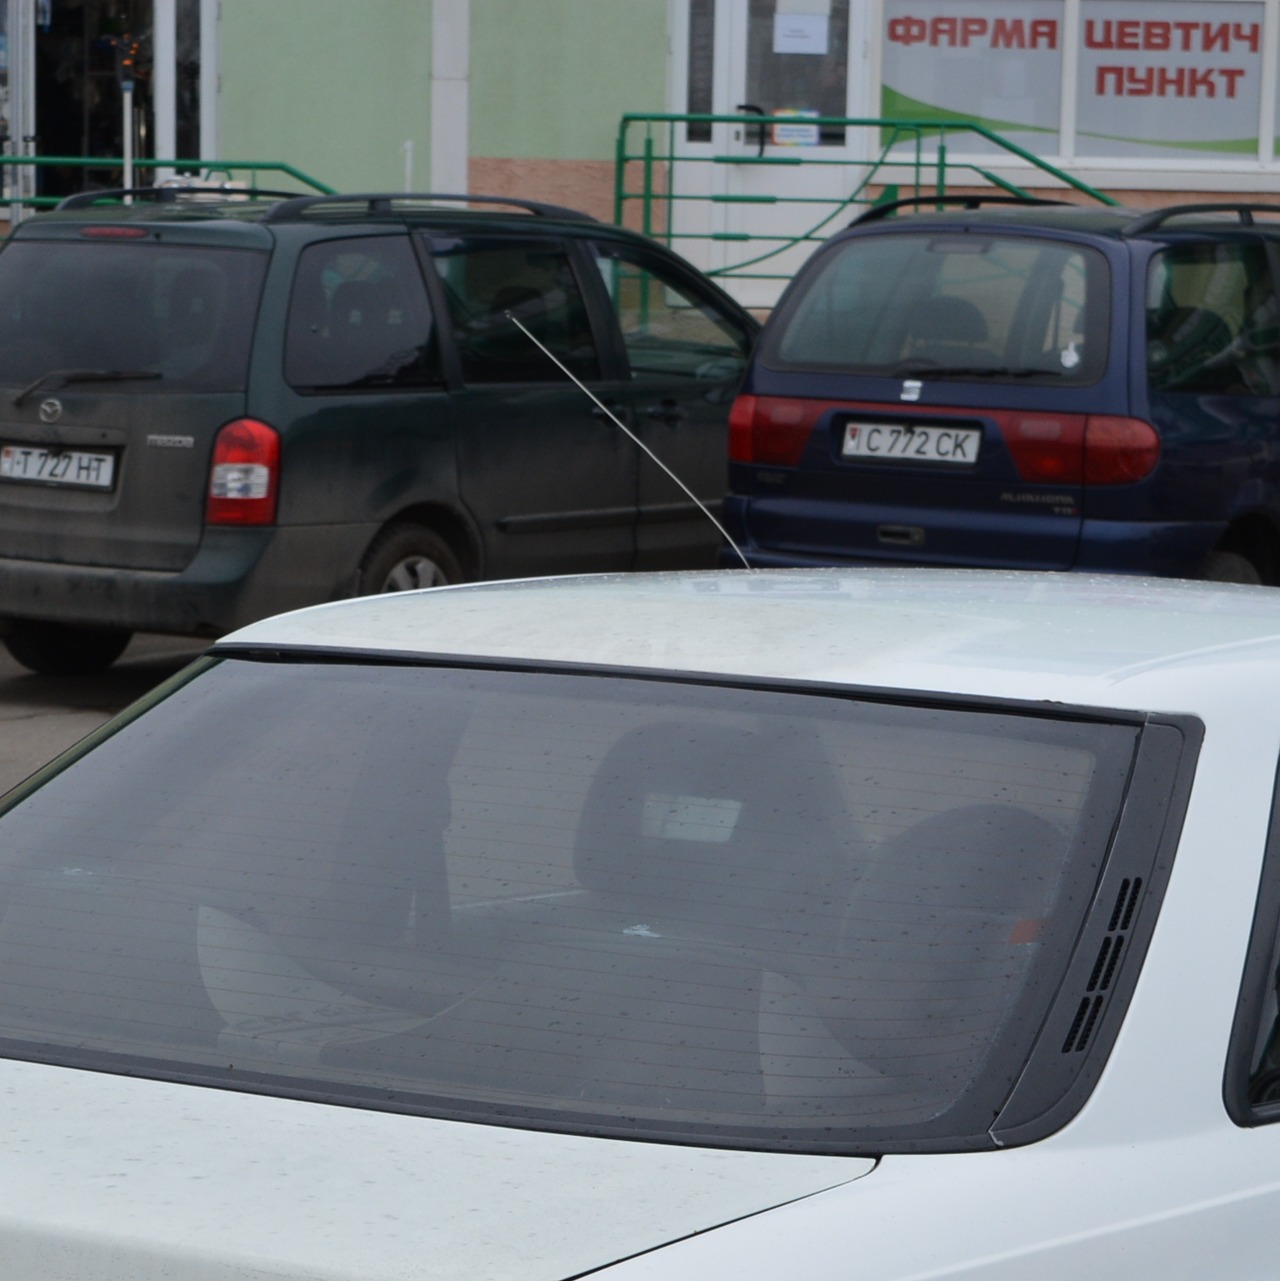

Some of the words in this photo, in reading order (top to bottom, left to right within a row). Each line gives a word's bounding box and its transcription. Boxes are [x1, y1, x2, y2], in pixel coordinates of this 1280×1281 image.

[887, 15, 1059, 49] ФАРМА
[1084, 19, 1261, 53] ЦЕВТИЧ
[1096, 65, 1246, 98] ПУНКТ
[866, 428, 881, 452] C
[886, 428, 929, 456] 772
[935, 432, 971, 459] CK
[37, 452, 72, 478] 727
